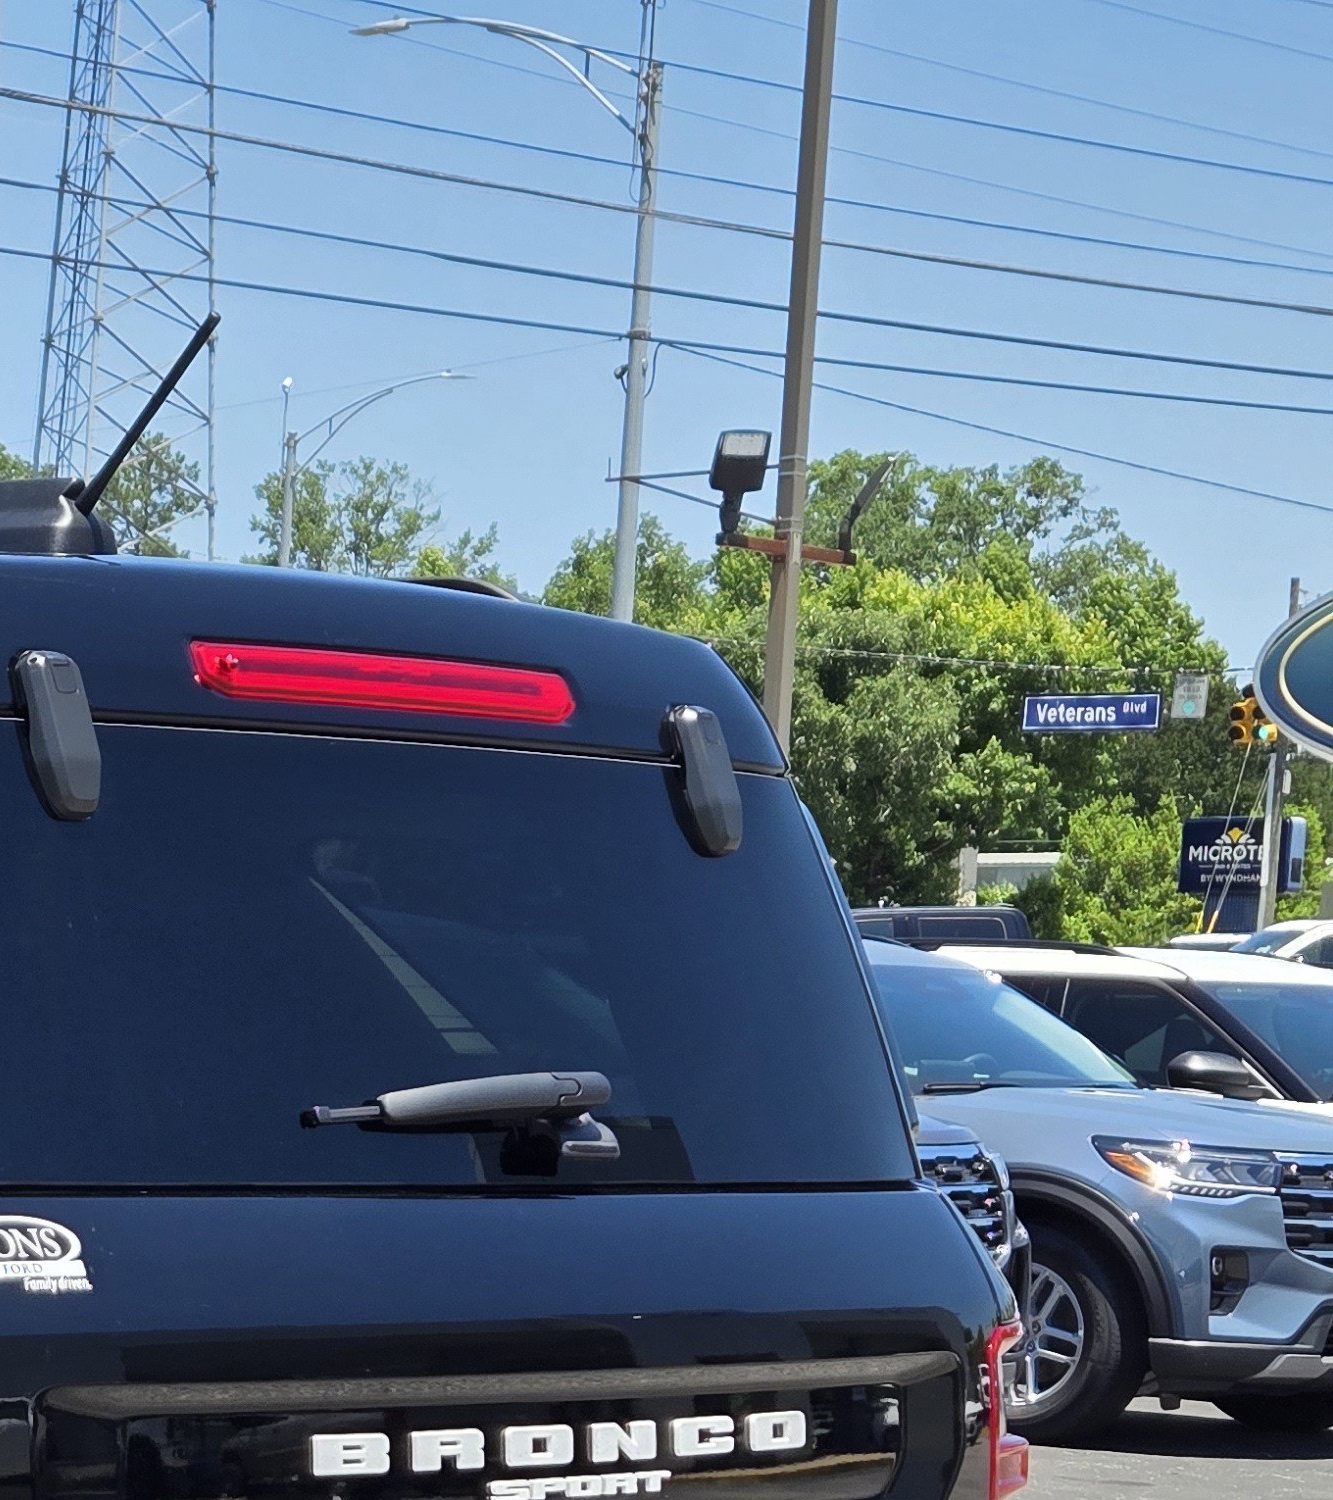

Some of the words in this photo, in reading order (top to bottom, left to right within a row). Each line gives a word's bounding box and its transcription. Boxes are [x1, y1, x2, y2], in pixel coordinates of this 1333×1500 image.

[1036, 702, 1117, 723] Veterans
[1122, 701, 1147, 714] Blvd
[1200, 873, 1213, 883] BY
[310, 1410, 807, 1477] BRONCO
